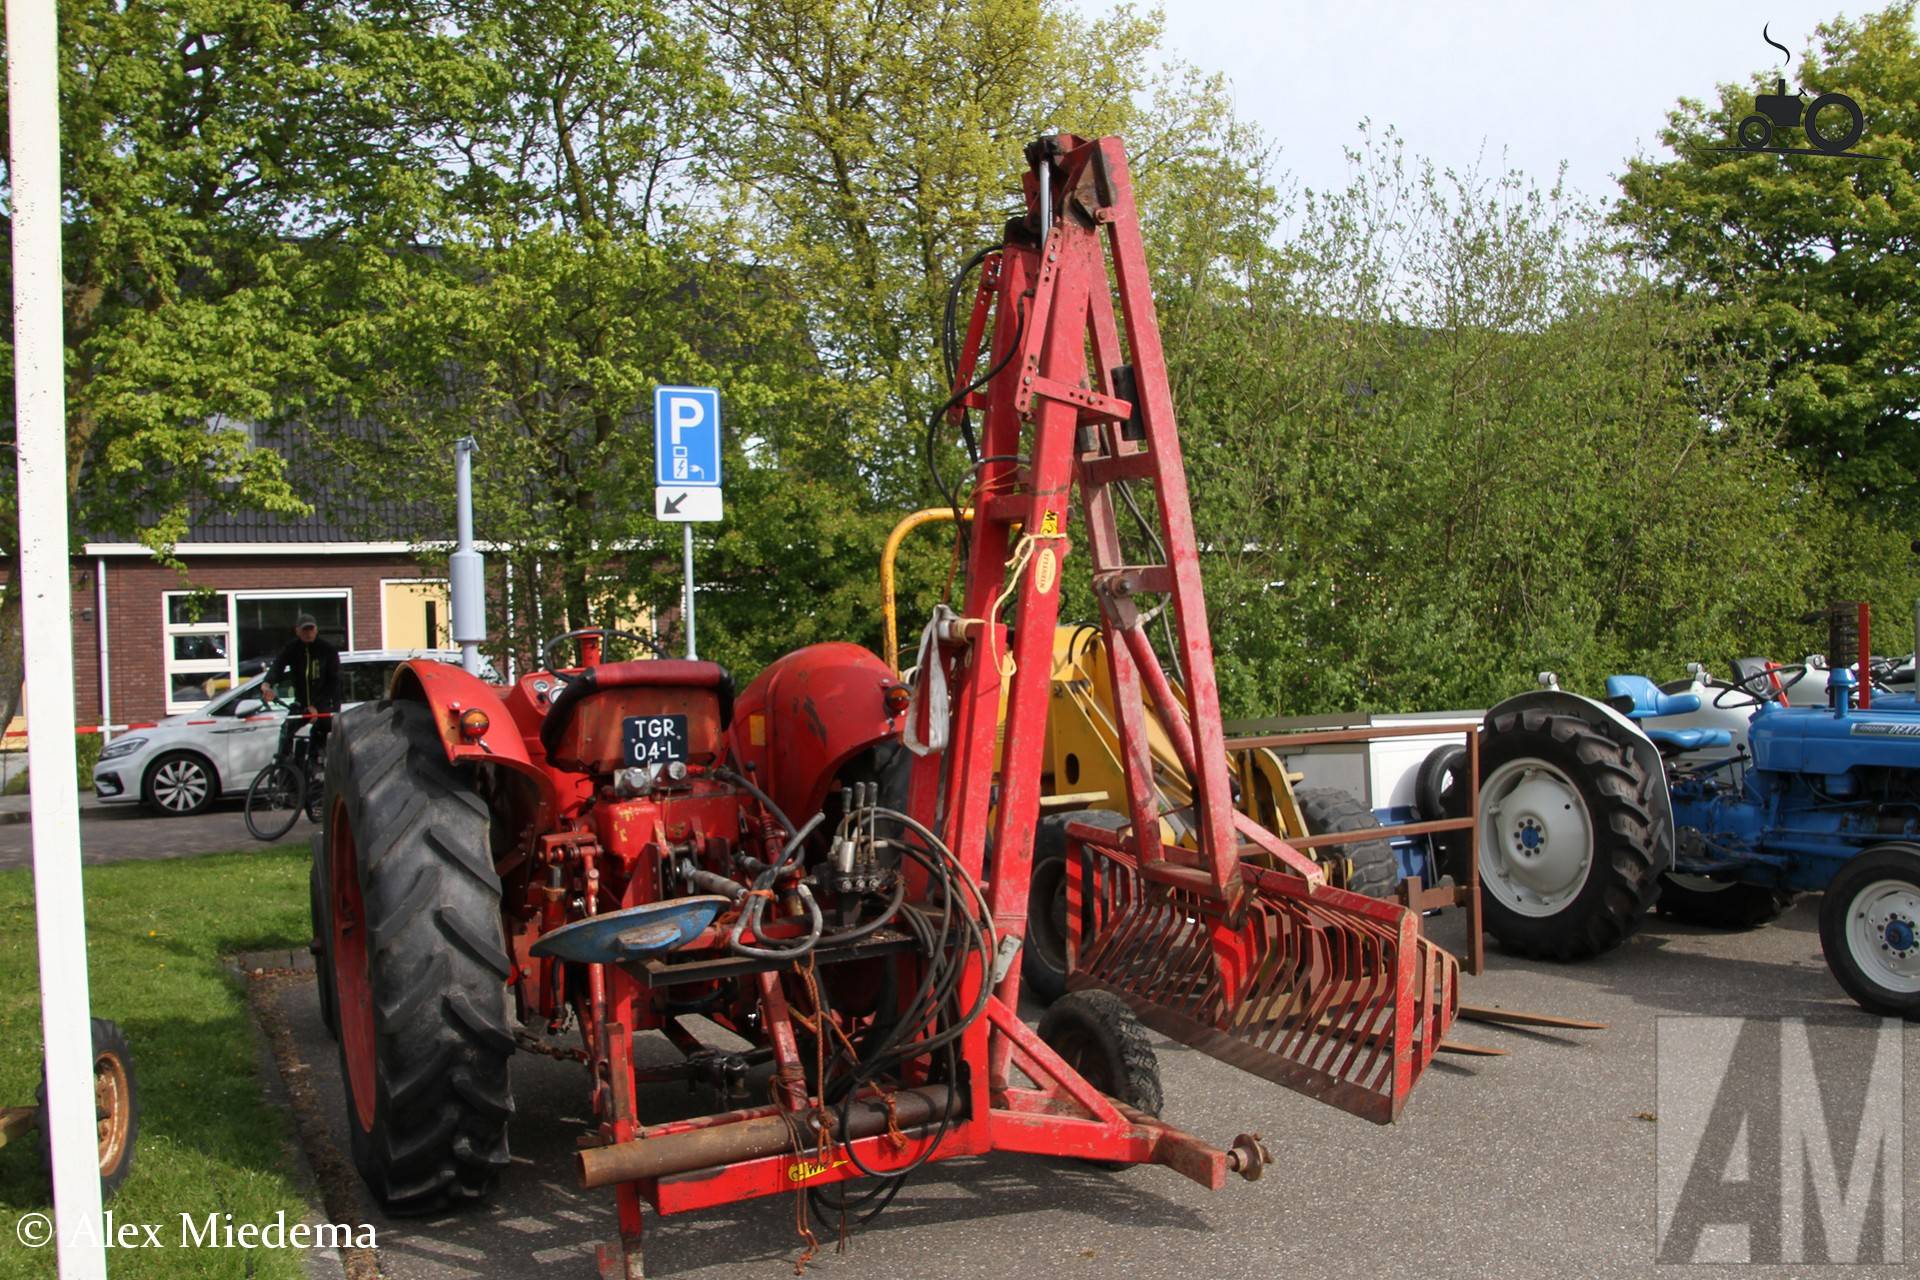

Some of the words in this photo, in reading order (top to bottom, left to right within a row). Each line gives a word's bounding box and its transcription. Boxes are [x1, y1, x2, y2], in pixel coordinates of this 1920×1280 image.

[670, 397, 705, 445] P
[634, 718, 675, 739] TGR
[634, 741, 680, 761] 04-L
